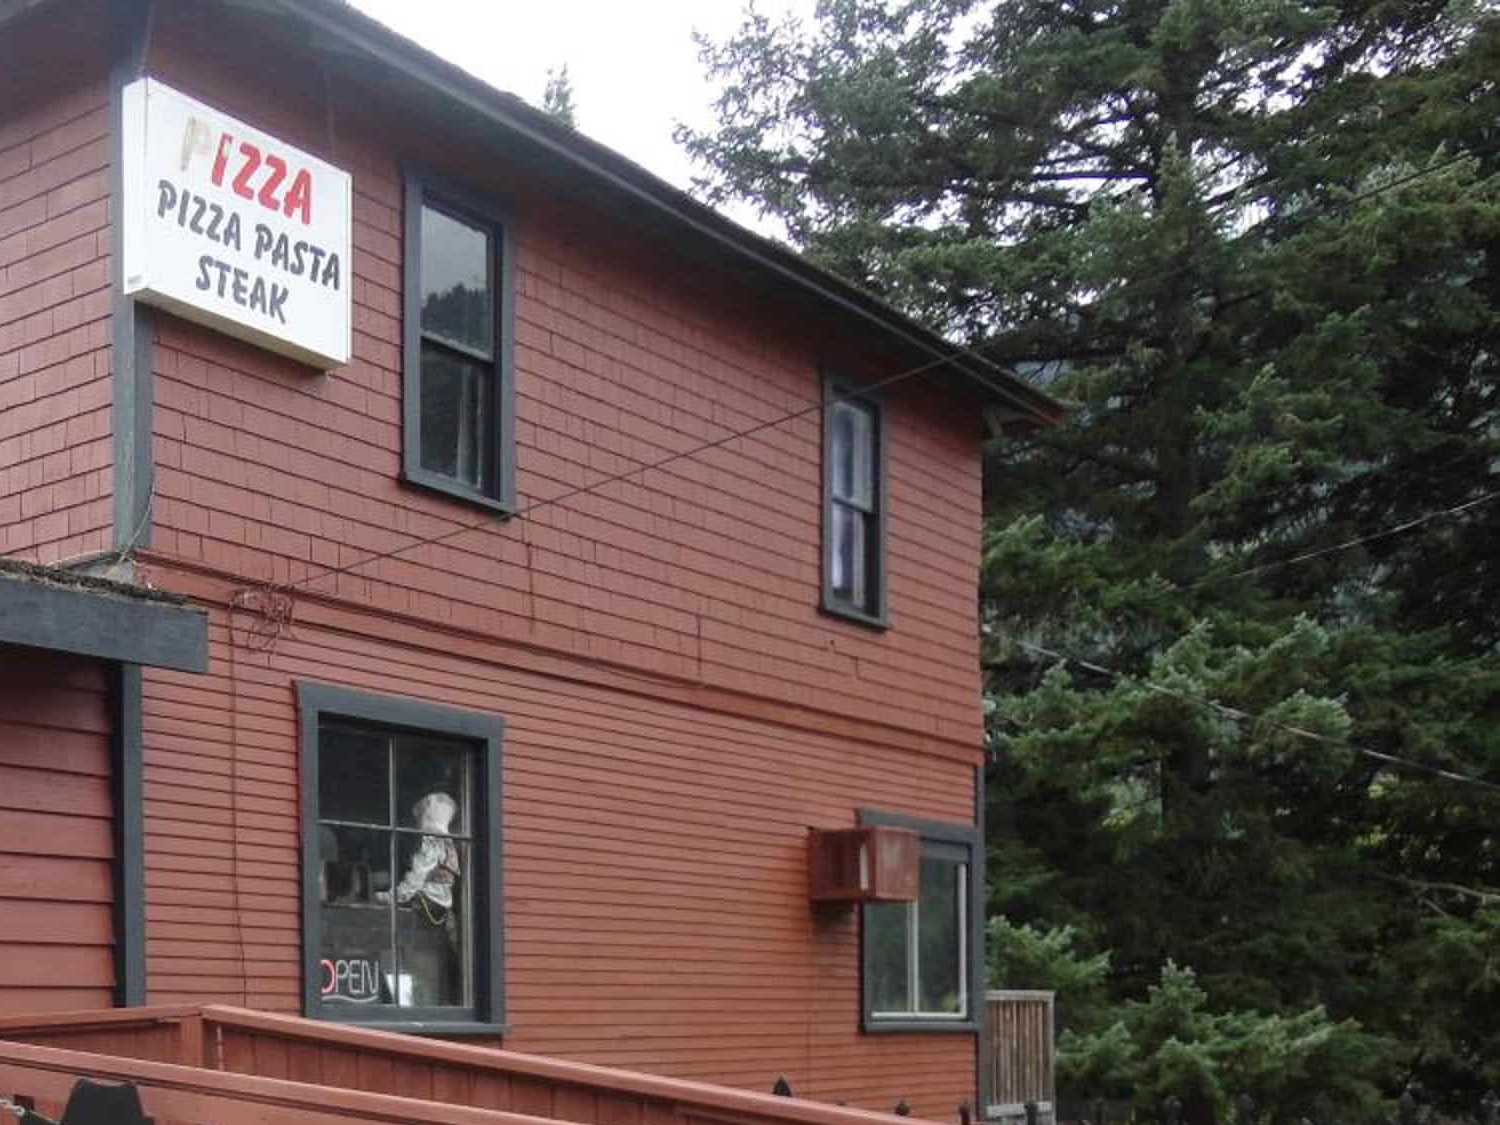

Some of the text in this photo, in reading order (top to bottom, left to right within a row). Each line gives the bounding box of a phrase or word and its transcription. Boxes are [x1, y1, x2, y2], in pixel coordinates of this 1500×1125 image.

[180, 117, 312, 225] PIZZA
[157, 179, 340, 291] PIZZA PASTA
[195, 255, 289, 324] STEAK
